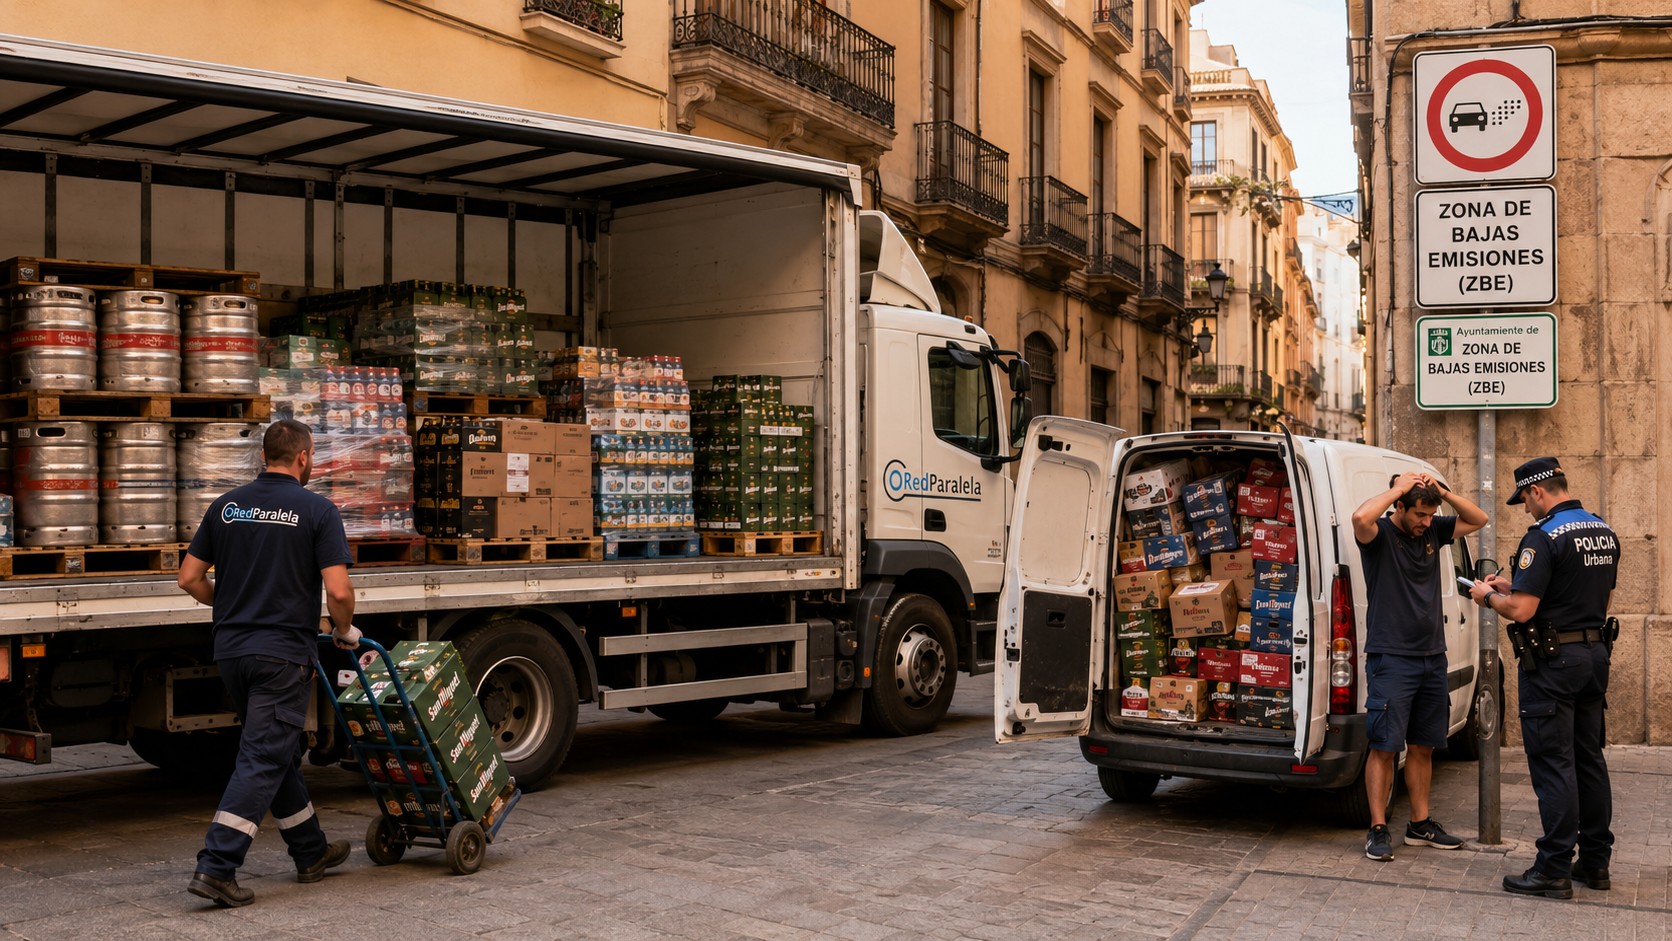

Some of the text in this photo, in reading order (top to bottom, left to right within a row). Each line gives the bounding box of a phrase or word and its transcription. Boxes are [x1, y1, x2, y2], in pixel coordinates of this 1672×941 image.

[1439, 200, 1531, 219] ZONA DE
[1452, 225, 1519, 242] BAJAS
[1428, 249, 1544, 268] EMISIONES
[1459, 274, 1513, 295] (ZBE)
[1526, 326, 1539, 334] de
[1462, 342, 1521, 355] ZONA DE
[1428, 361, 1545, 374] BAJAS EMISIONES
[1468, 381, 1505, 396] (ZBE)
[1574, 535, 1616, 552] POLICIA
[1583, 553, 1613, 566] Urbana
